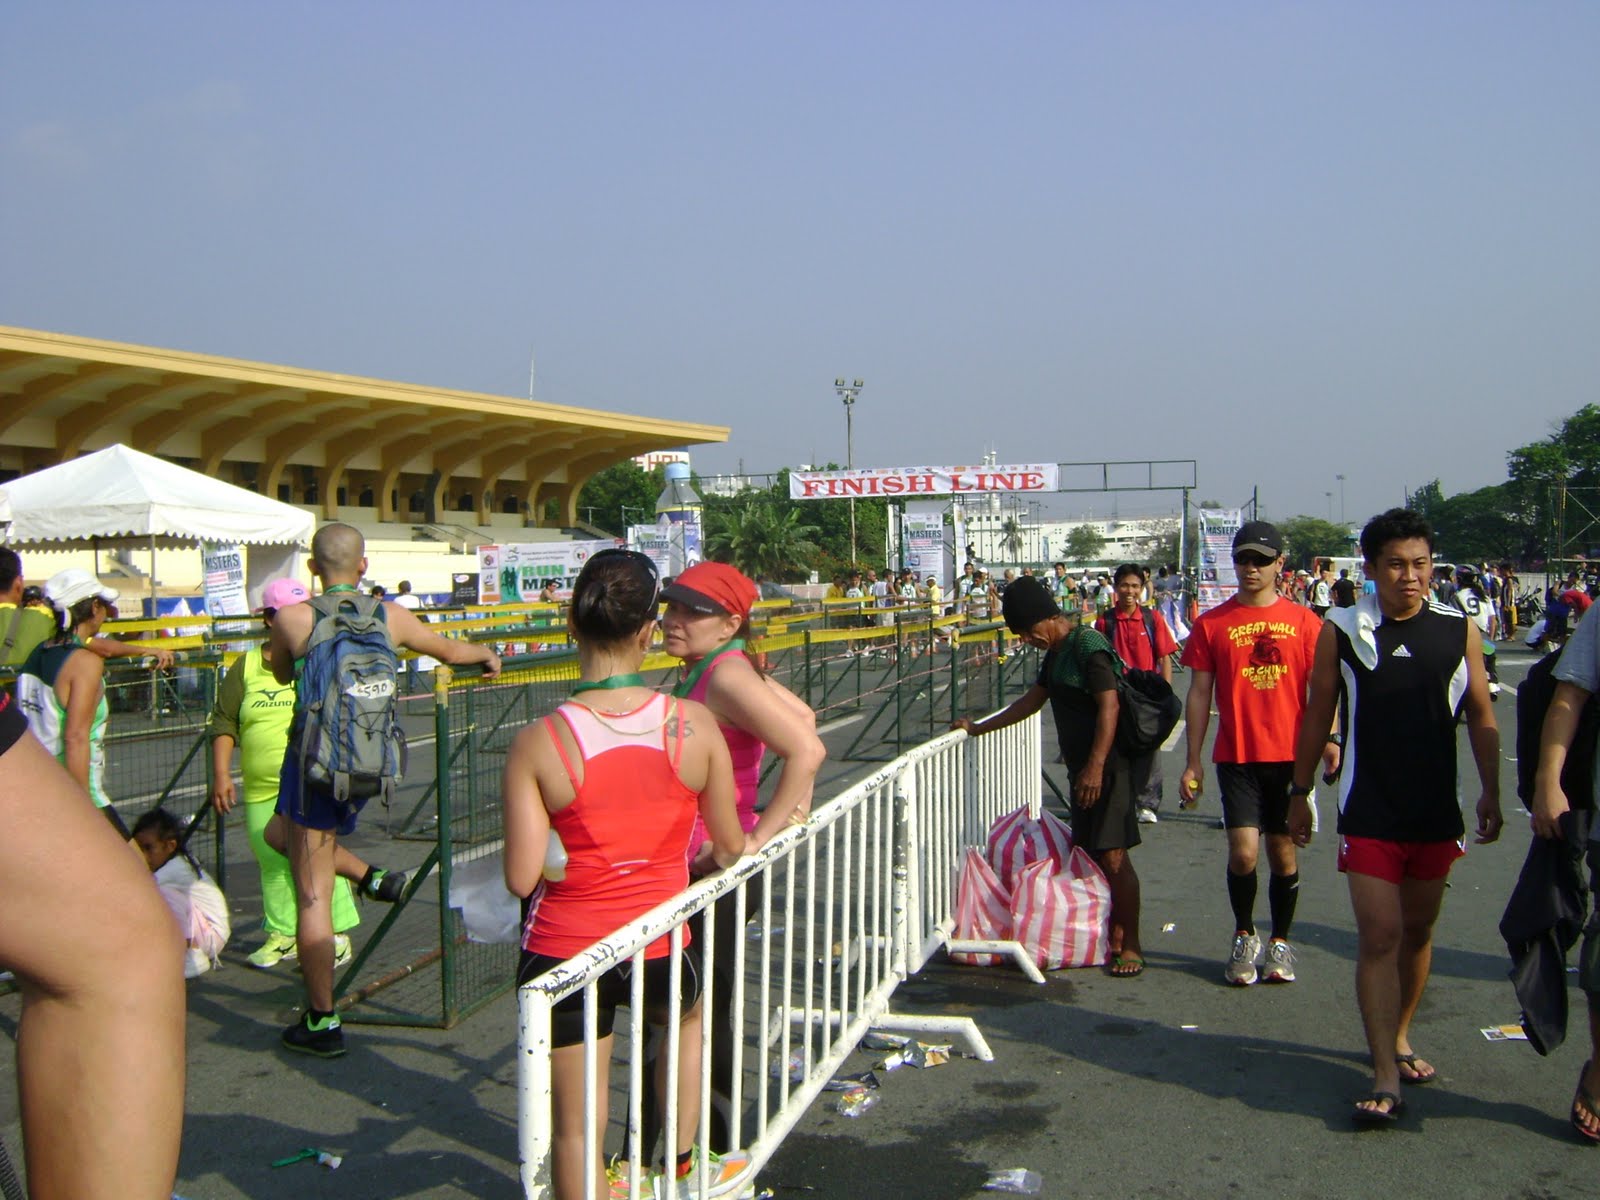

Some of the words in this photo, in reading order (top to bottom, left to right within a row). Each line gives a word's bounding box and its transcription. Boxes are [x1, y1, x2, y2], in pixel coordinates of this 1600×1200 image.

[802, 474, 936, 497] FINISH
[949, 472, 1046, 491] LINE
[909, 530, 942, 539] MASTERS
[640, 540, 669, 550] MASTERS
[522, 564, 566, 577] RUN
[1466, 597, 1481, 617] 9
[1229, 621, 1267, 640] GREAT
[1268, 621, 1297, 637] WALL
[1241, 667, 1255, 677] OF
[1256, 664, 1288, 675] CHINA
